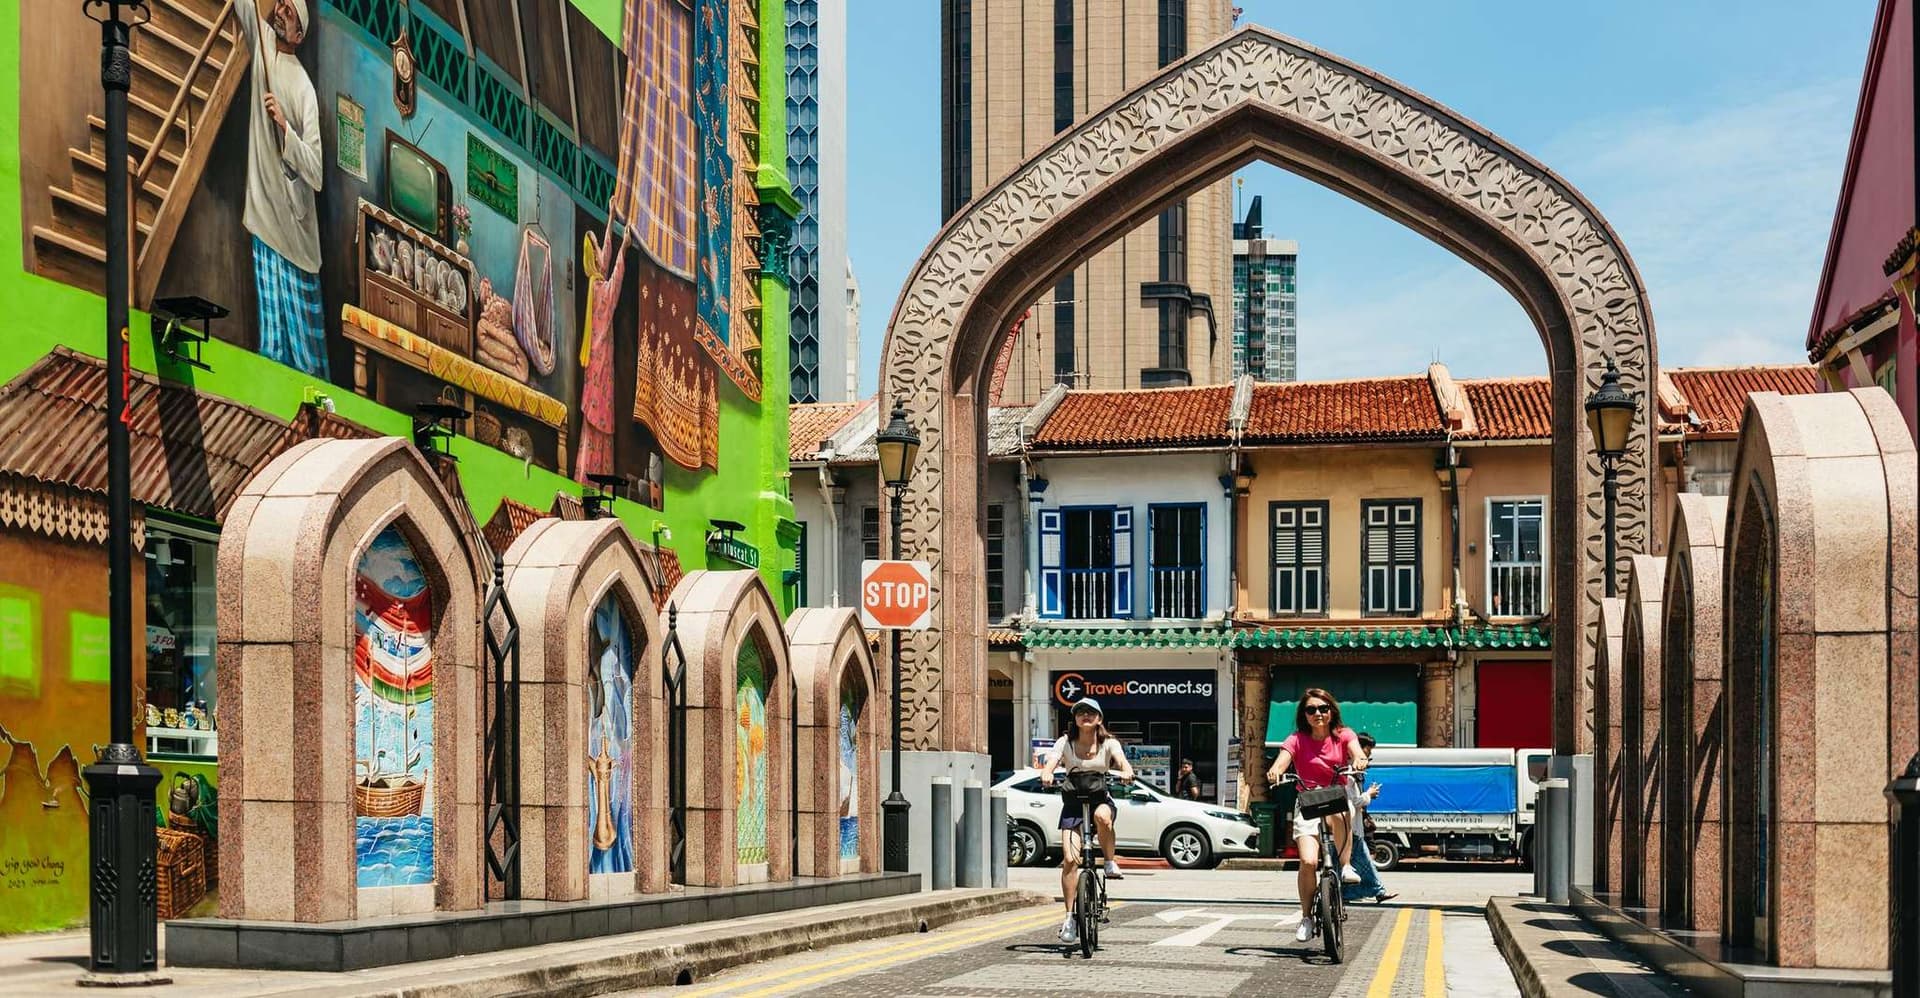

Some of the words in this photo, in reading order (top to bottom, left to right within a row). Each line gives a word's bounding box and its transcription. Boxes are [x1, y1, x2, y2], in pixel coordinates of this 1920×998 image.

[866, 581, 927, 609] STOP
[1083, 680, 1213, 697] TravelConnect.sg
[1375, 816, 1421, 824] ONSTRUCTION
